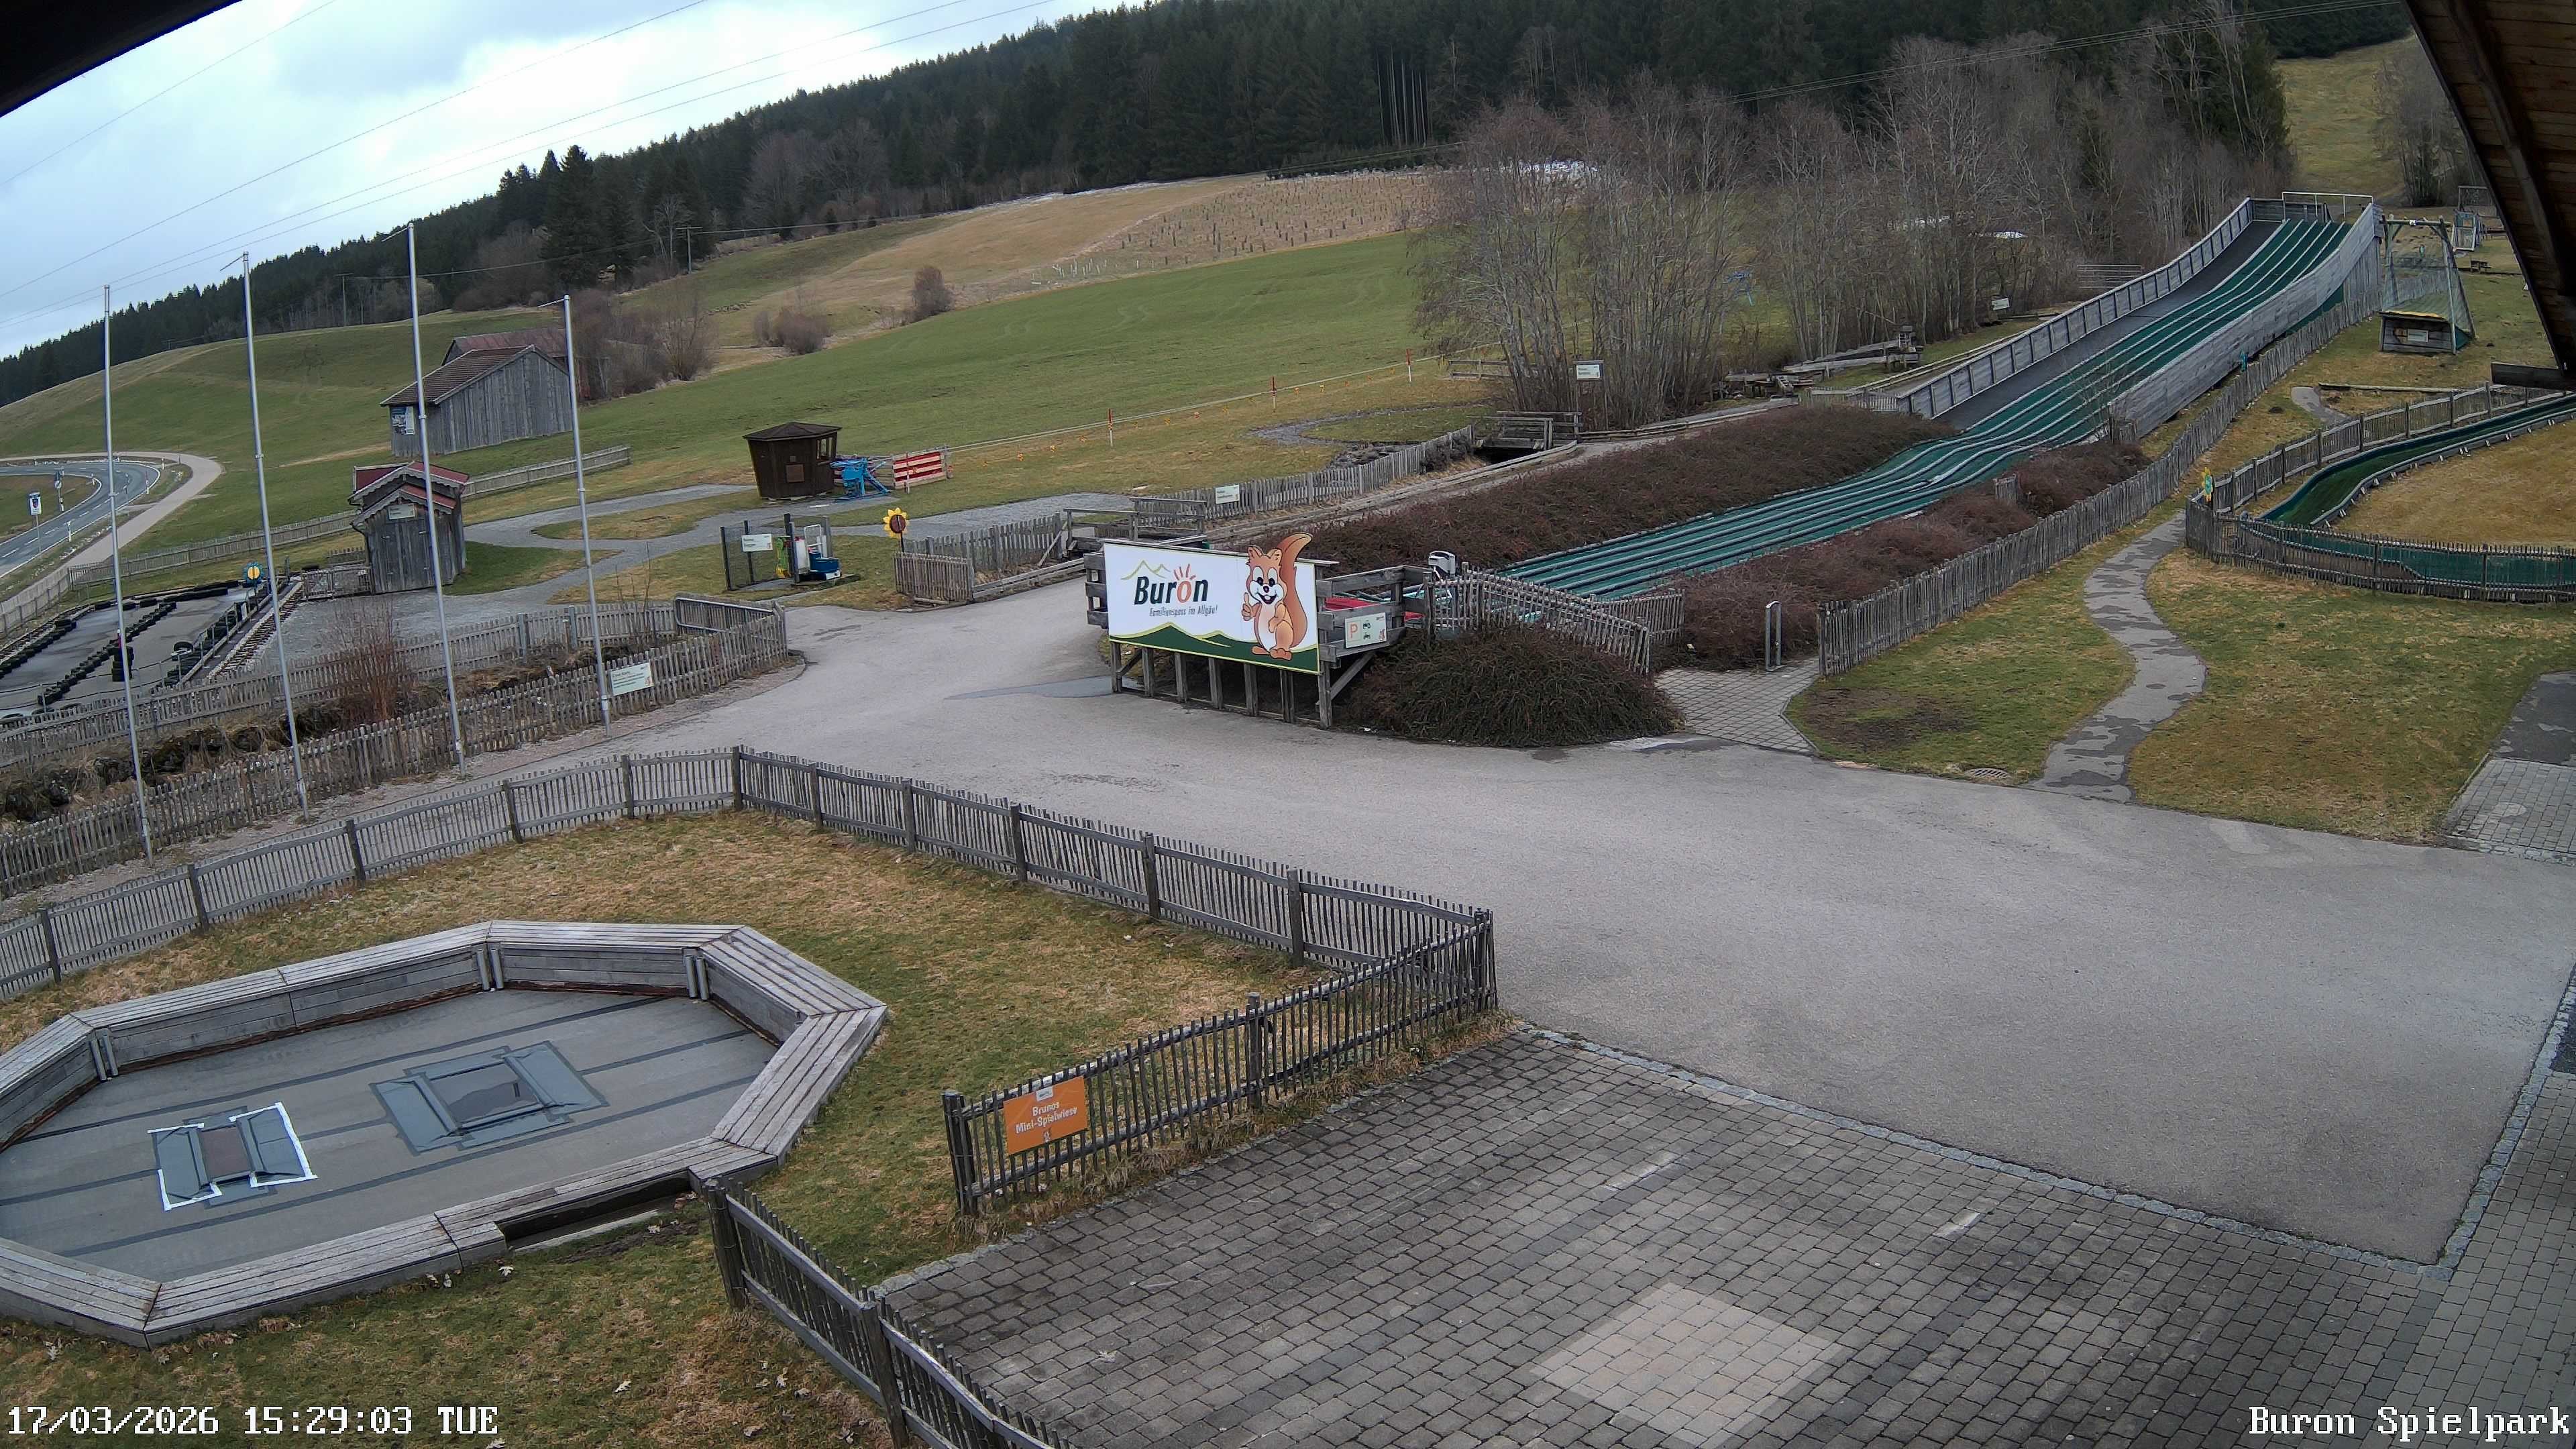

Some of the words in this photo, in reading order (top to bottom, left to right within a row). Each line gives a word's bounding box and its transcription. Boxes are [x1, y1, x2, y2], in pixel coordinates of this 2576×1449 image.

[1134, 576, 1209, 605] Buron
[1188, 606, 1195, 615] im
[1197, 604, 1218, 616] Allgäu!
[1350, 623, 1358, 639] P
[1032, 1102, 1061, 1117] Brunos
[1015, 1107, 1078, 1134] Mini-Spielwiese
